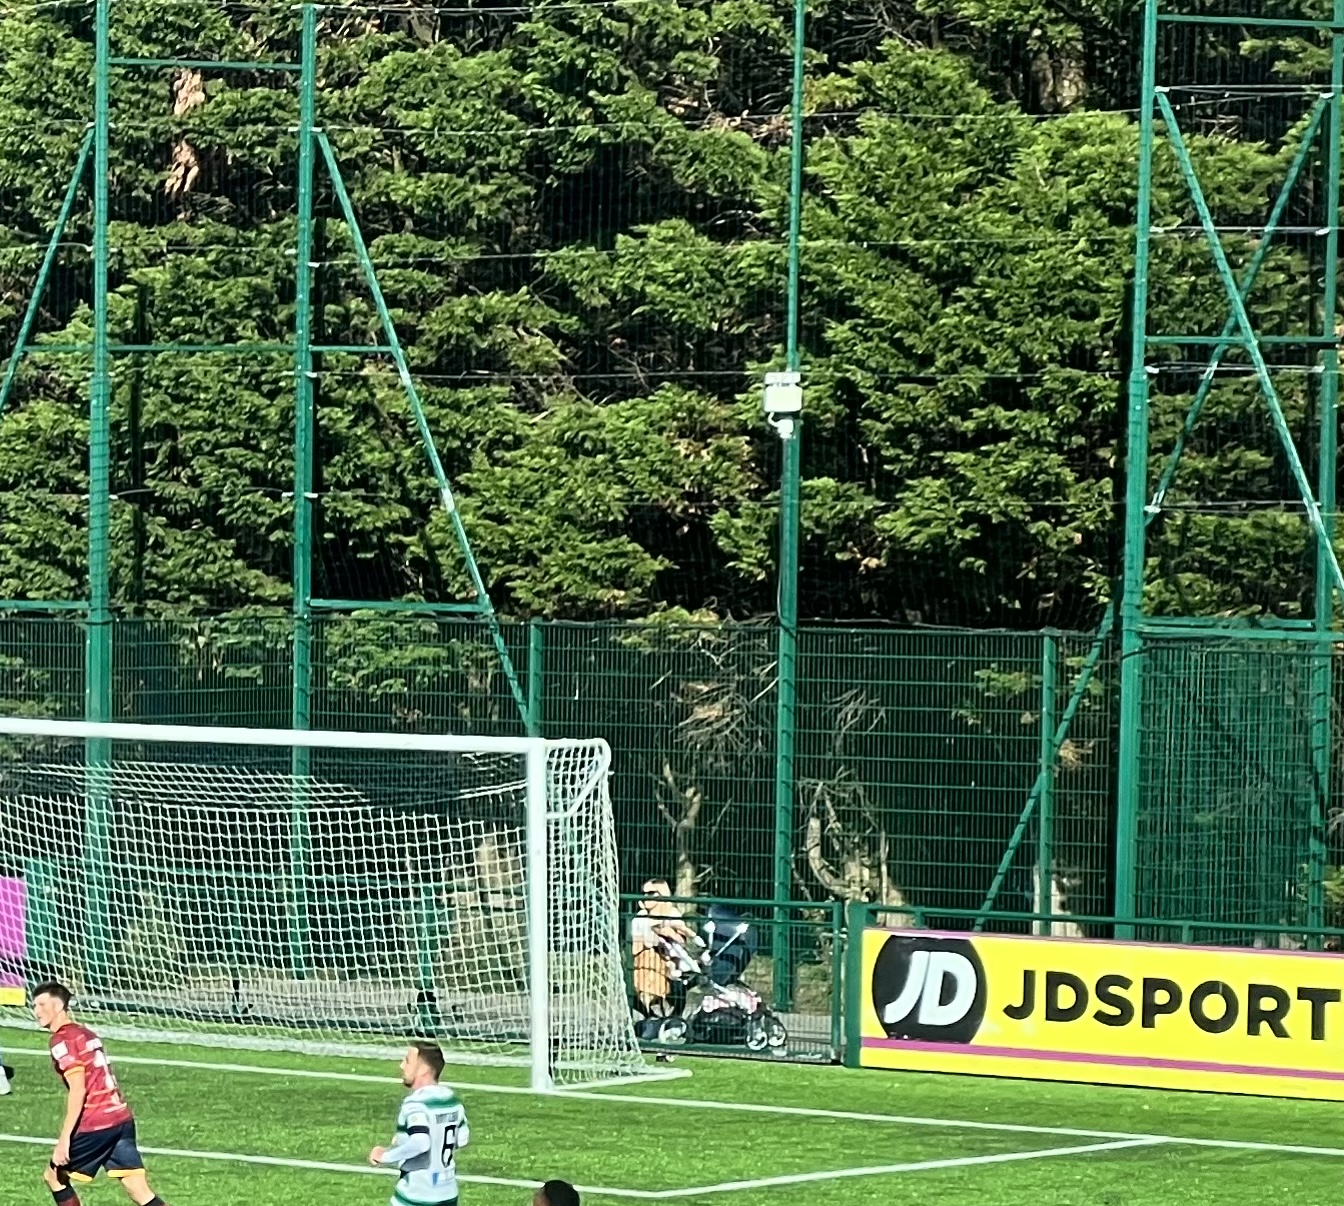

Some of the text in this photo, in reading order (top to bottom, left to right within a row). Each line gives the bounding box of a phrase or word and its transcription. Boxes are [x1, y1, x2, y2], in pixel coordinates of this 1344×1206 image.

[884, 950, 978, 1026] JD
[1003, 969, 1342, 1041] JDSPORT
[441, 1125, 457, 1168] 6
